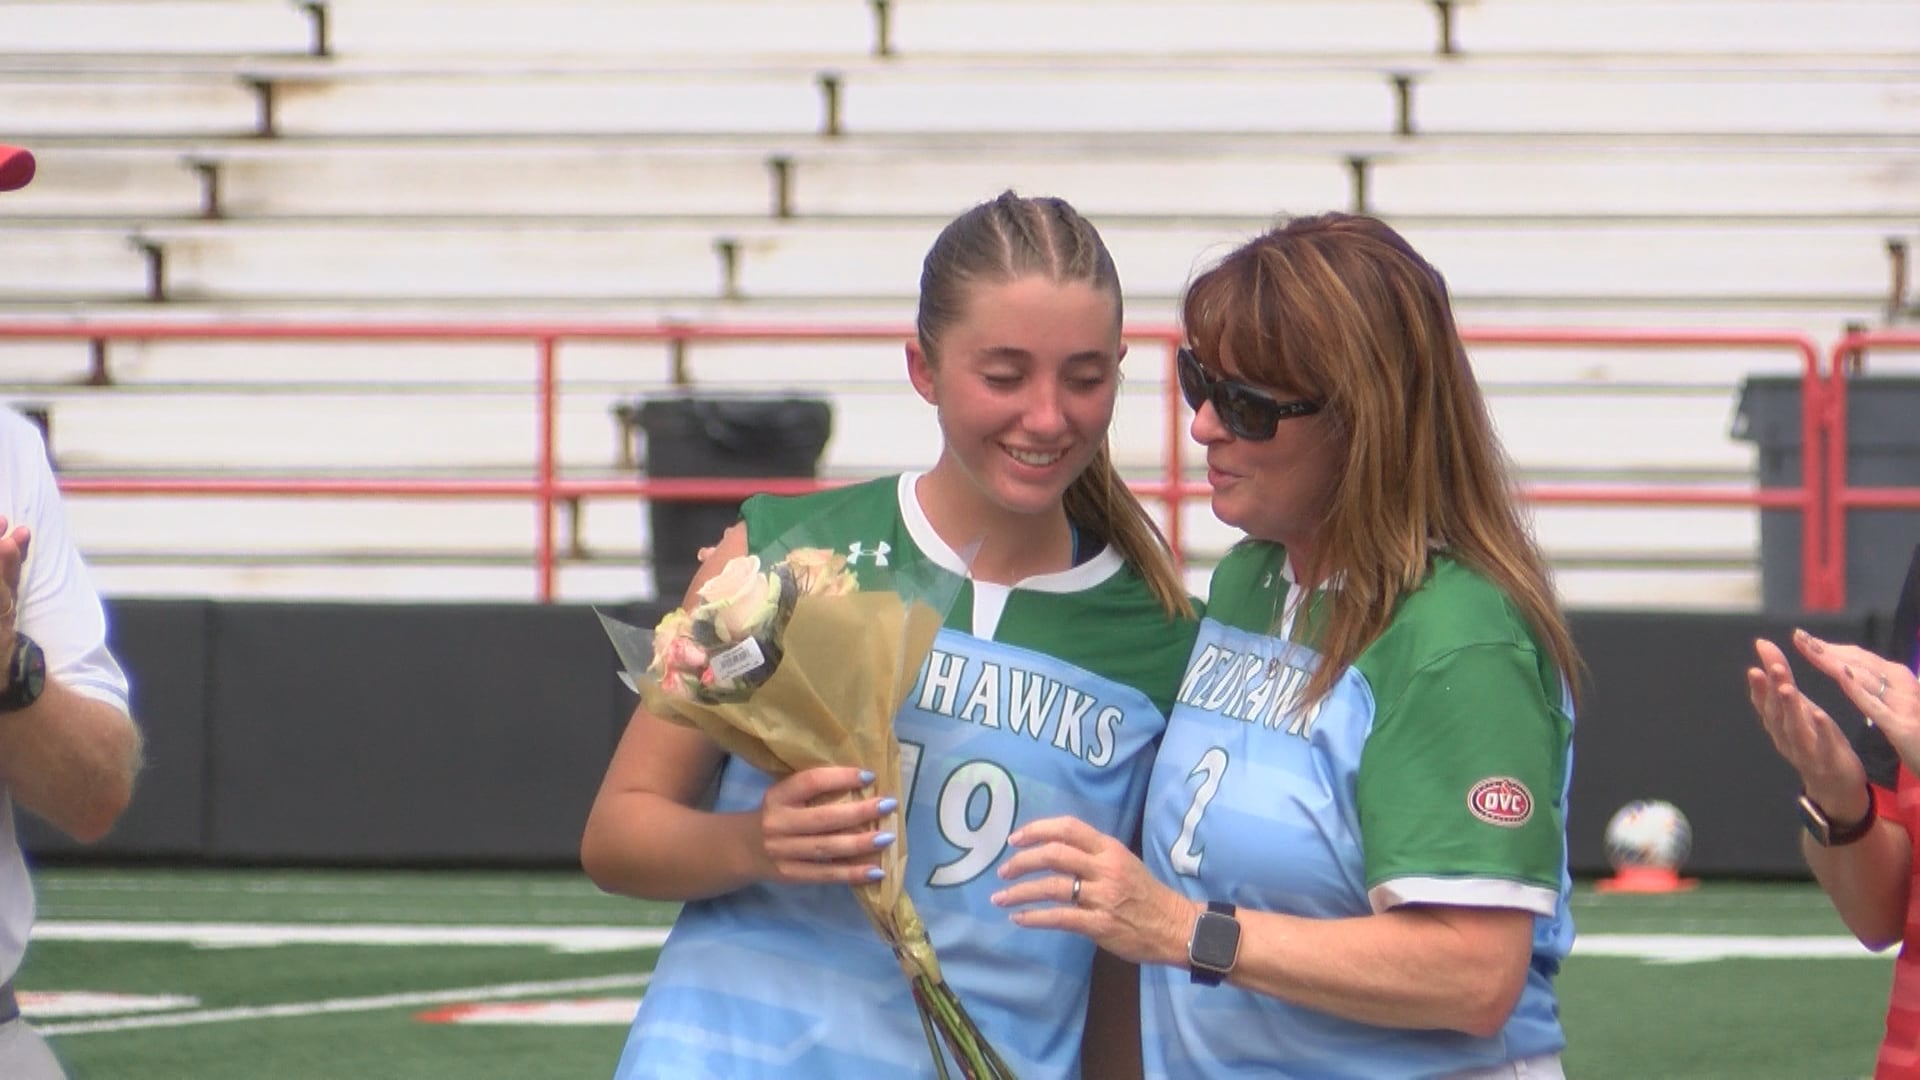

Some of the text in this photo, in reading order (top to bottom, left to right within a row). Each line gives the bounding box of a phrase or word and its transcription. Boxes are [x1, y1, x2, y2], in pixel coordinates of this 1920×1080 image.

[910, 649, 1124, 768] HAWKS
[1169, 747, 1230, 878] 2
[1485, 792, 1521, 813] OVC
